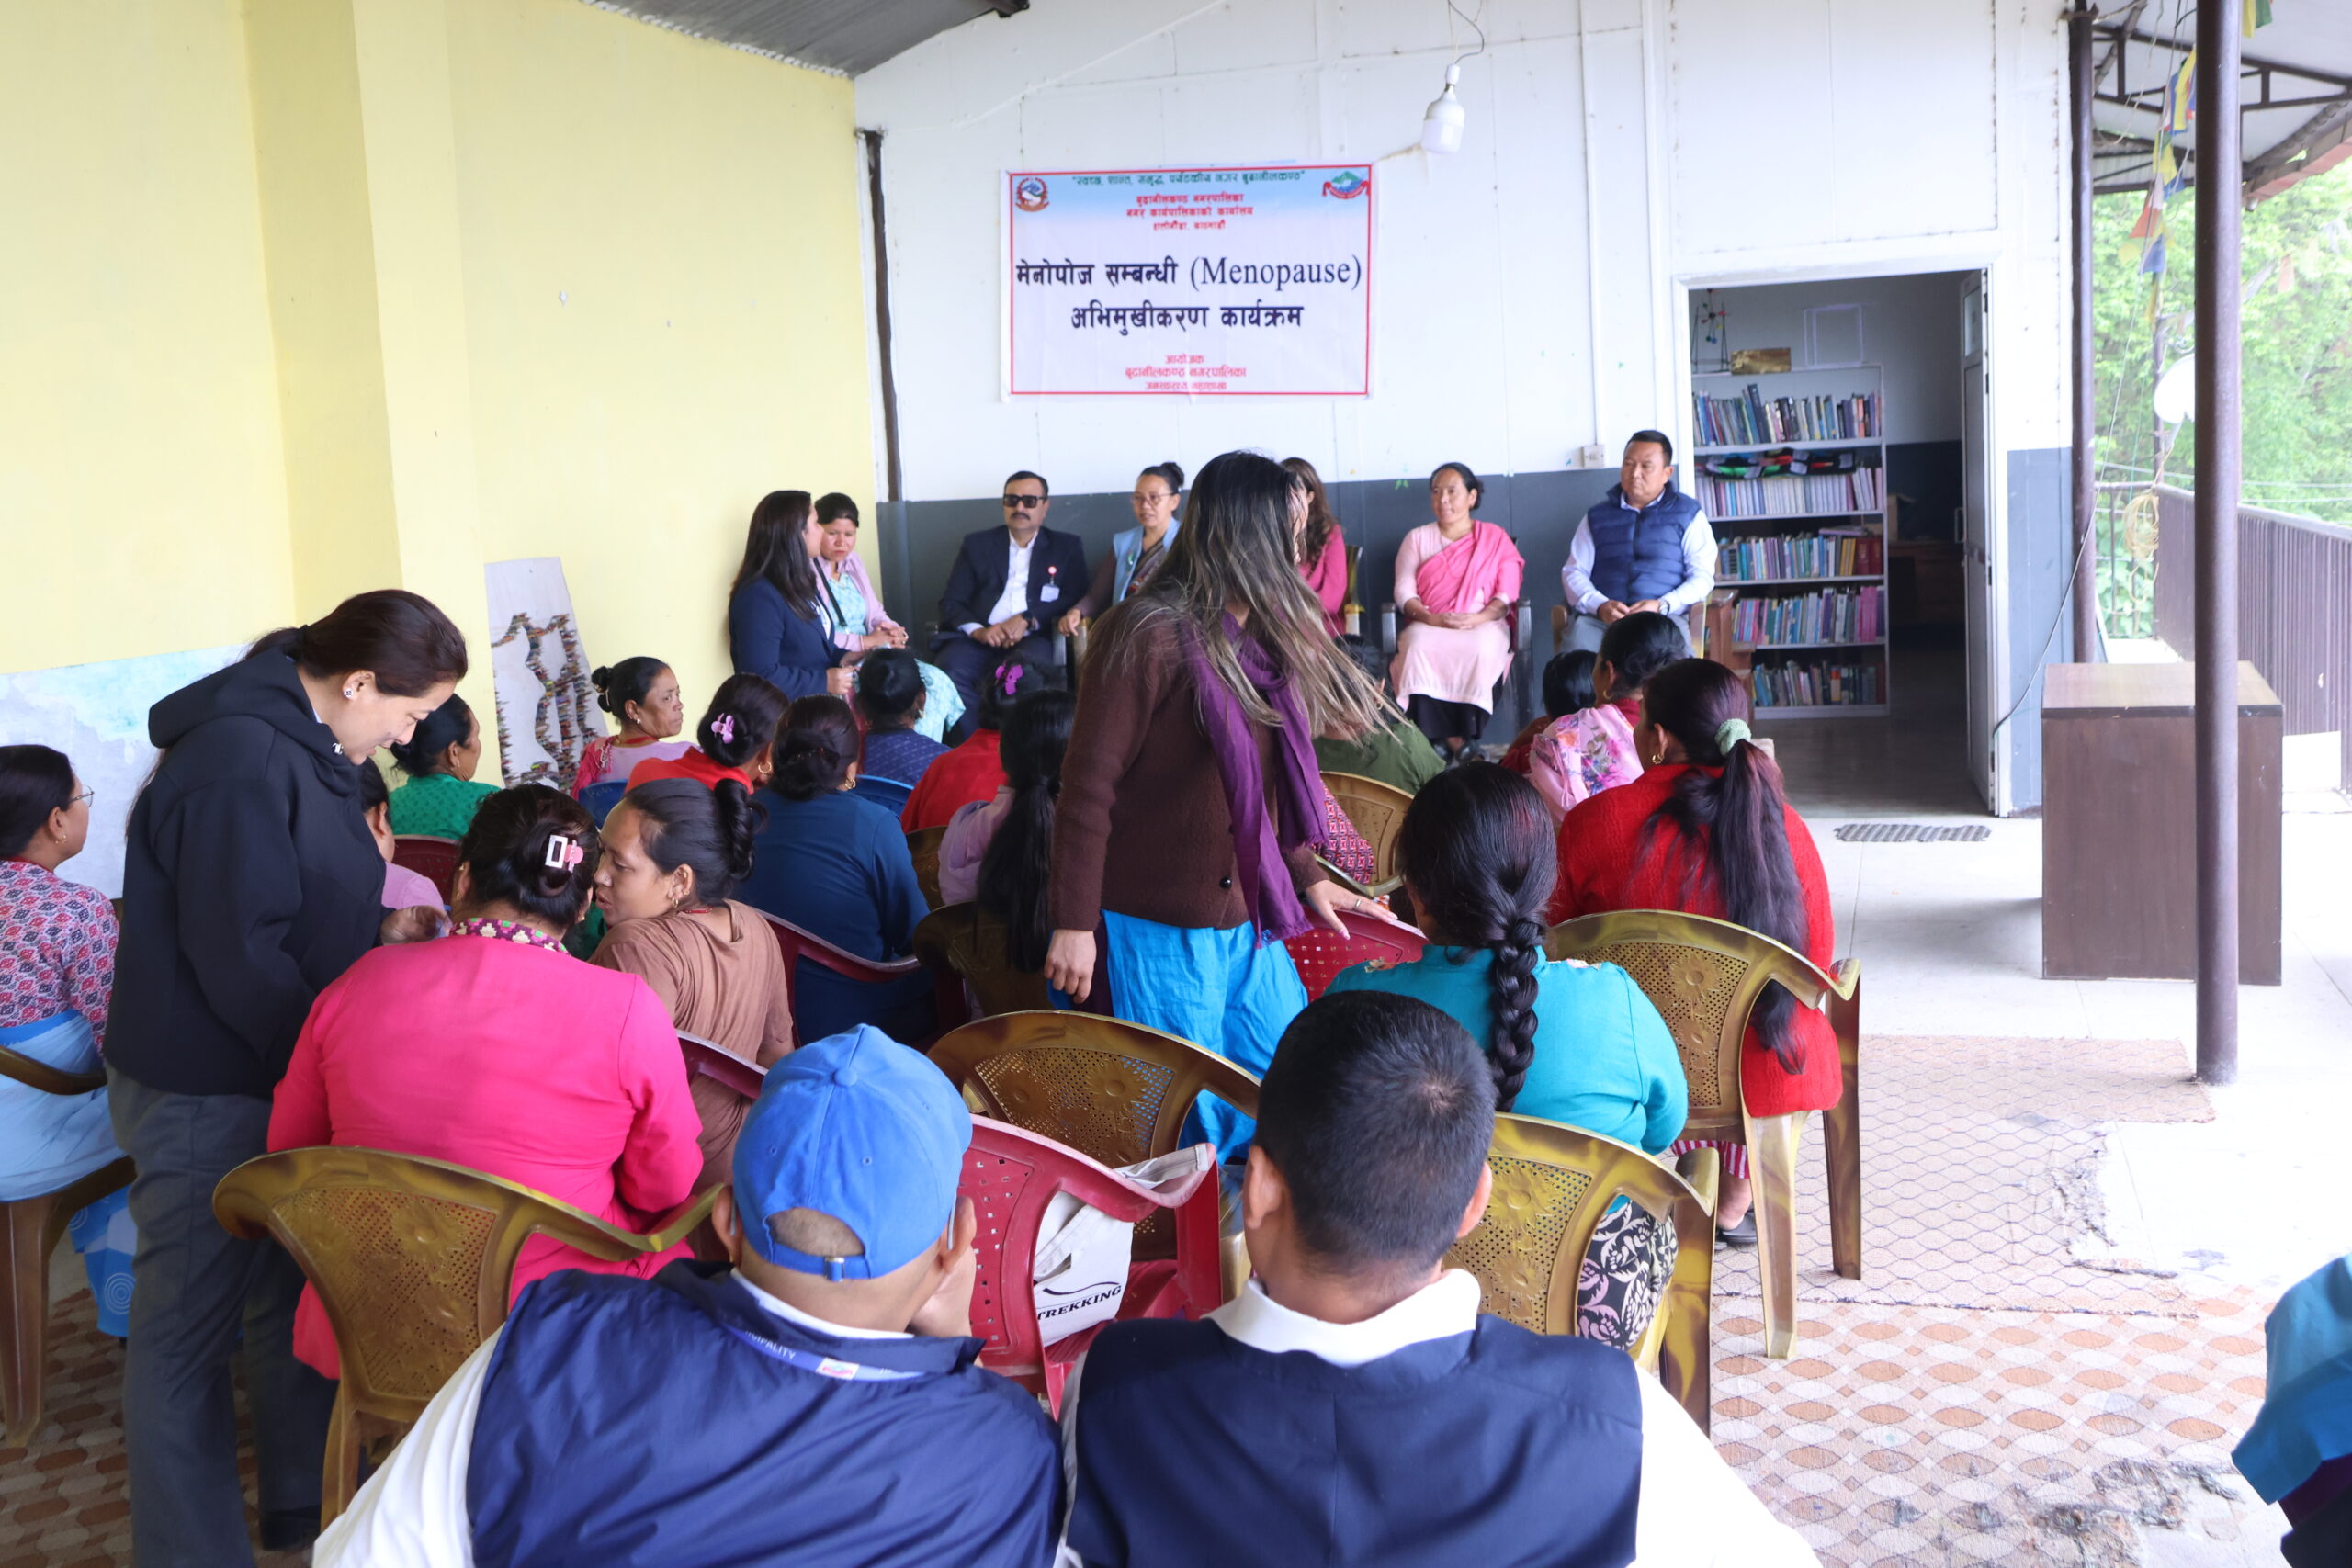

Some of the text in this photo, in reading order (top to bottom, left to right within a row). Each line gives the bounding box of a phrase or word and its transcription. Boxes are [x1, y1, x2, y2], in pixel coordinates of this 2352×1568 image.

[1016, 254, 1362, 292] मेनोपोज सम्बन्धी (Menopause)
[1071, 299, 1305, 336] अभिमुखीकरण कार्यक्रम
[1037, 1285, 1122, 1321] TREKKING
